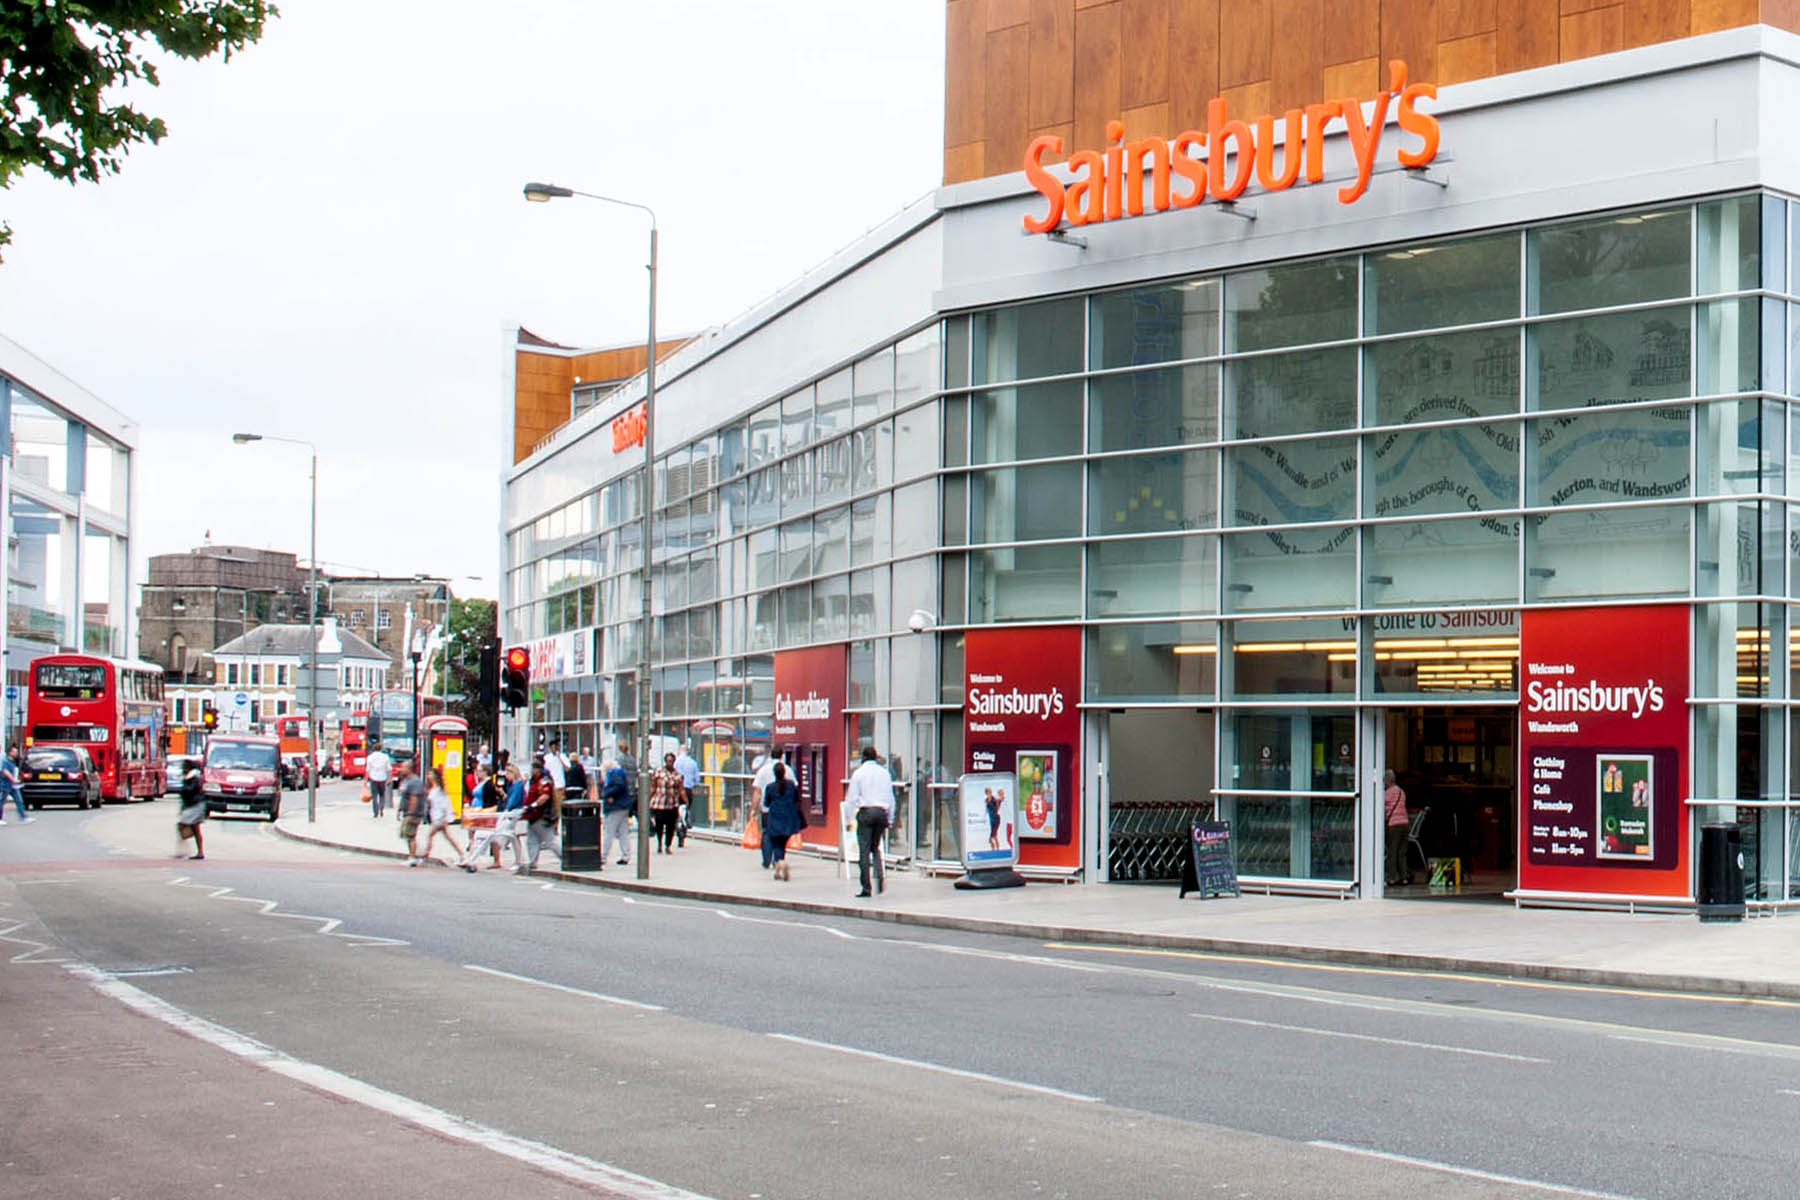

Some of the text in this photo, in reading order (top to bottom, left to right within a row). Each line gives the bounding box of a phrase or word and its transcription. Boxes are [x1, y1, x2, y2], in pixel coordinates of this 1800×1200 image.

[1022, 58, 1441, 234] Sainsbury's
[1276, 449, 1309, 490] Wandle
[1419, 394, 1457, 412] derived
[1496, 431, 1513, 452] Old
[1392, 494, 1408, 509] the
[1409, 476, 1455, 505] boroughs
[1456, 486, 1468, 498] of
[1552, 475, 1596, 506] Merton,
[1598, 478, 1620, 494] and
[1622, 473, 1691, 498] Wandswort
[1420, 612, 1437, 629] to
[1528, 663, 1575, 675] Welcome to
[775, 690, 829, 721] Cash machines
[969, 687, 1063, 720] Sainsbury's
[1527, 679, 1664, 719] Sainsbury's
[1528, 721, 1579, 733] Wandsworth
[1533, 756, 1565, 770] Clothing
[1541, 768, 1562, 780] Home
[1533, 800, 1573, 813] Phoneshop
